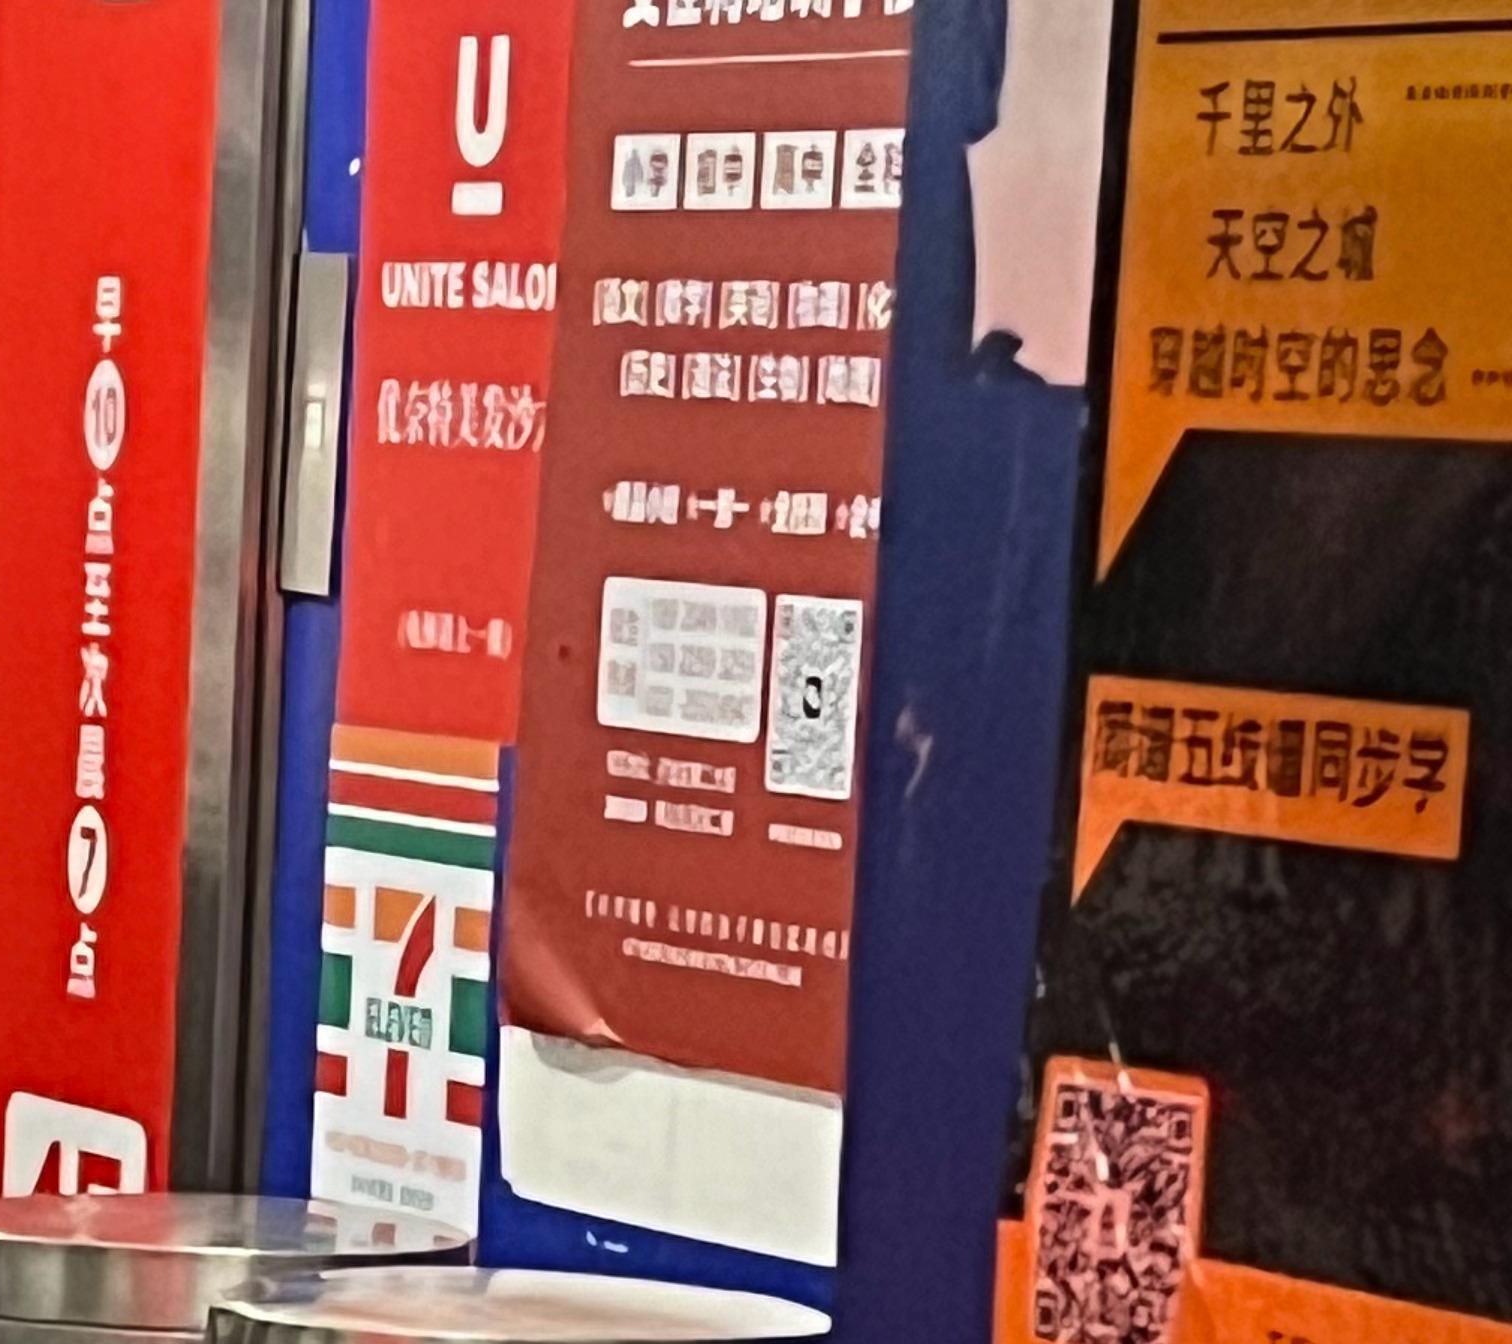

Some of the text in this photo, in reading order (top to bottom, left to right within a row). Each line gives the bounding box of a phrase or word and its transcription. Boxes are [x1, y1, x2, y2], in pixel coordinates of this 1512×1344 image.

[1196, 76, 1364, 158] 千里之外
[1207, 204, 1378, 282] 天空之城
[381, 261, 467, 308] UNITE
